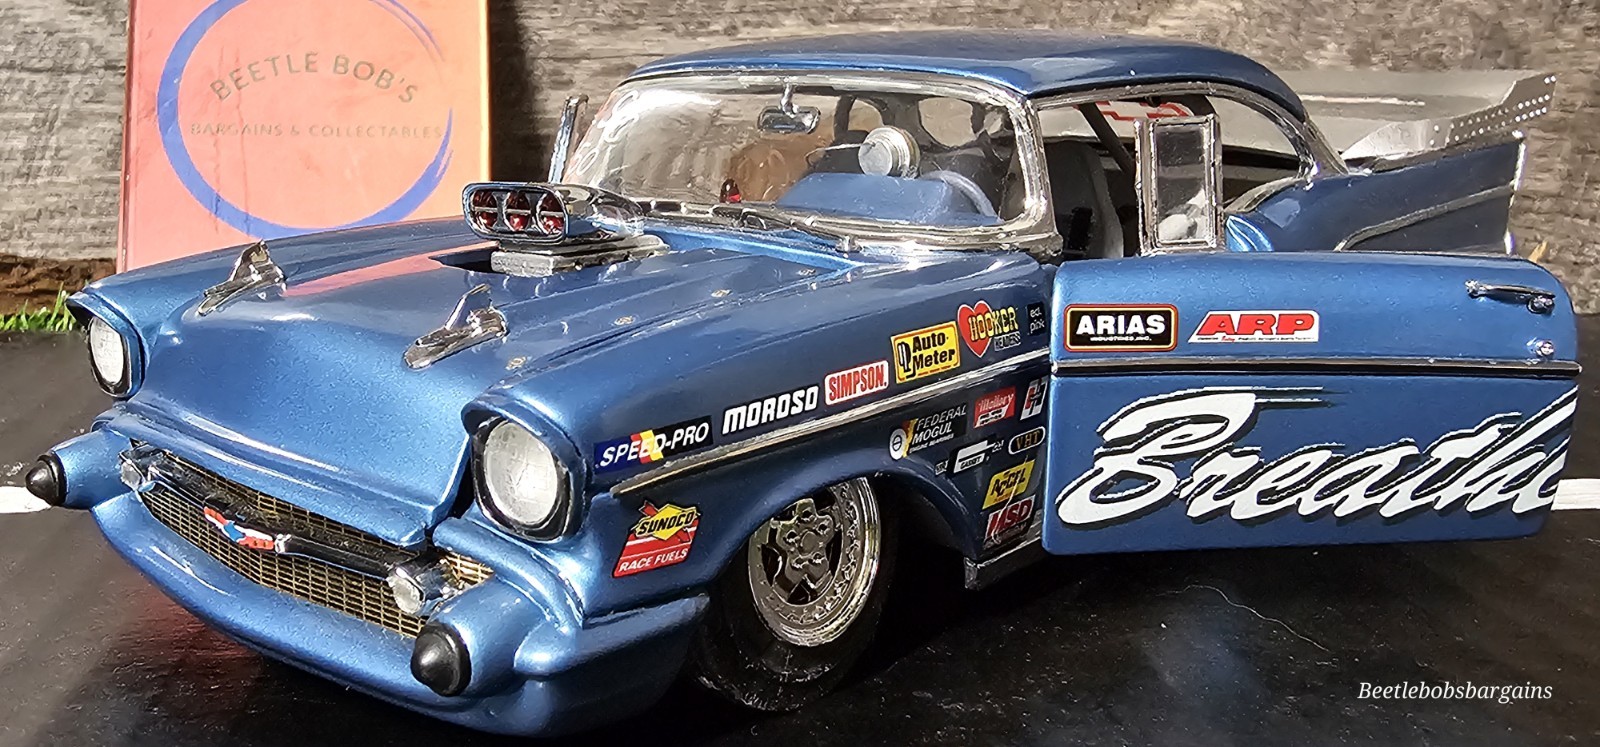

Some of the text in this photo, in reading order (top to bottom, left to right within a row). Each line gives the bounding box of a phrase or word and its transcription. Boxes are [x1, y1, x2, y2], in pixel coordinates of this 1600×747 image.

[209, 51, 419, 104] BEETLE BOB'S
[190, 122, 283, 137] BARGAINS
[308, 123, 442, 138] COLLECTABLES
[968, 306, 1019, 342] HOOKER
[1075, 314, 1166, 335] ARIAS
[1195, 313, 1315, 336] ARP
[910, 349, 956, 374] Meter
[721, 385, 820, 435] MOROSO
[978, 393, 1015, 413] Mallory
[916, 404, 967, 431] FEDERAL
[599, 421, 710, 467] SPEED-PRO
[911, 421, 953, 445] MOGUL
[1015, 430, 1041, 450] VHT
[636, 510, 695, 536] SUNOCO
[986, 498, 1035, 539] MSD
[618, 548, 689, 572] RACE FUELS
